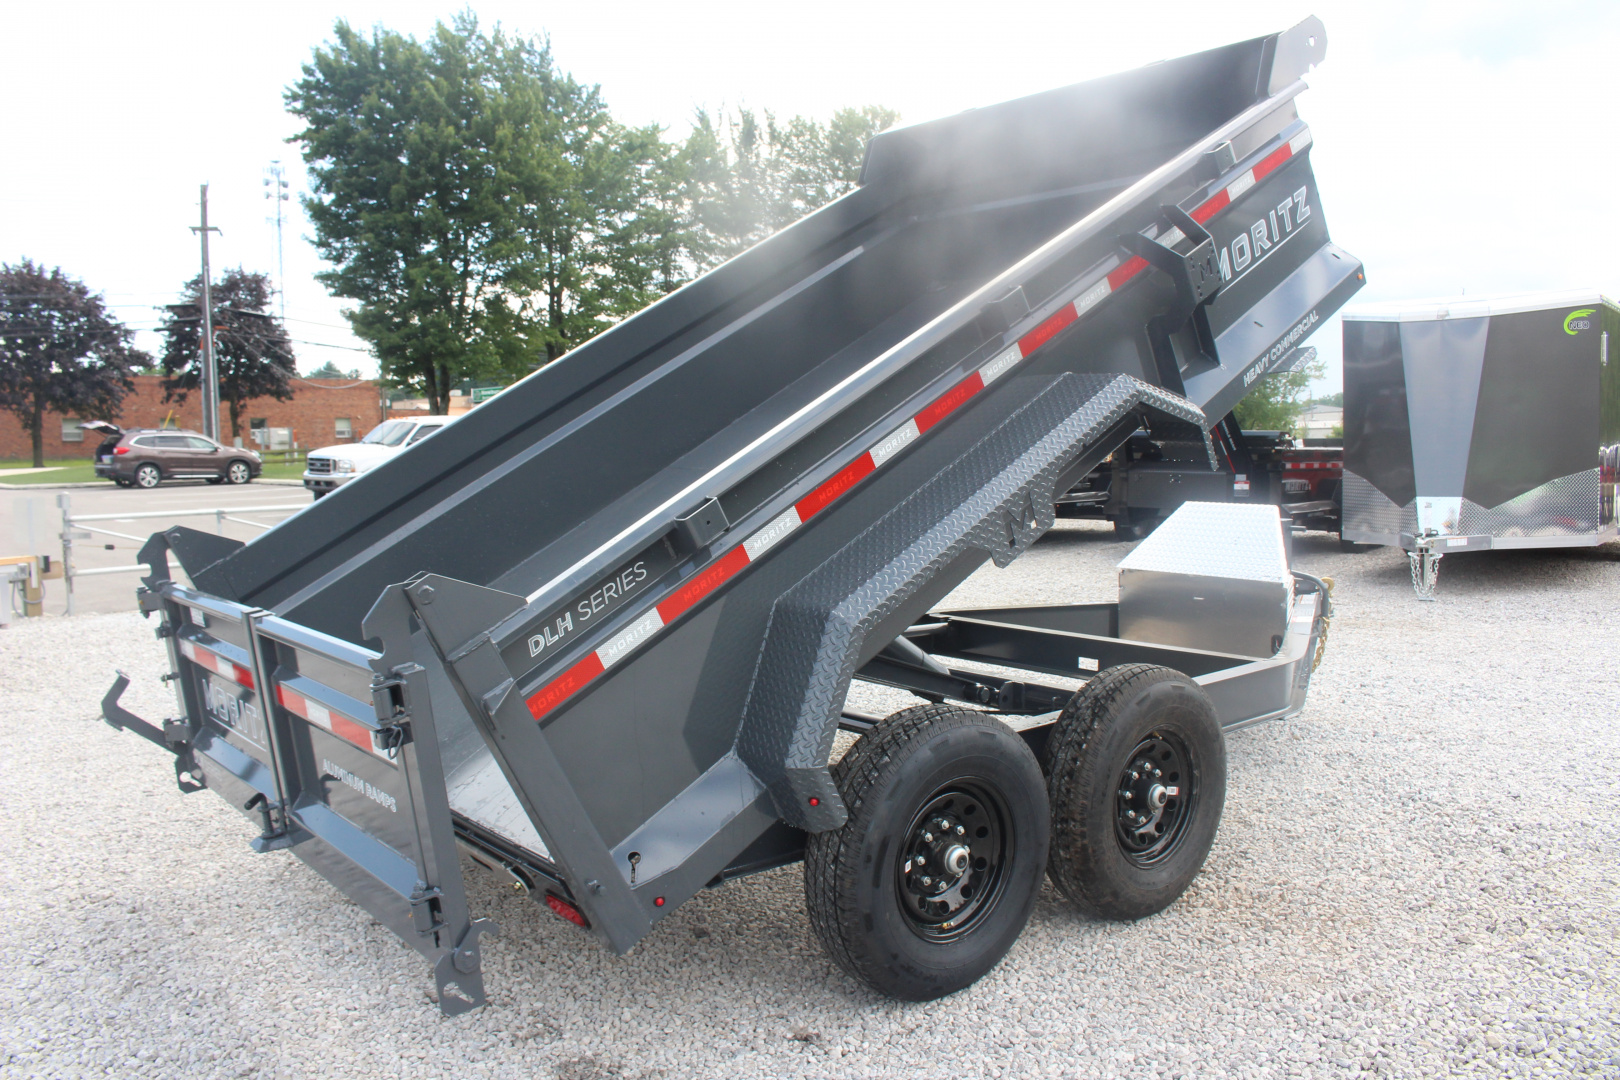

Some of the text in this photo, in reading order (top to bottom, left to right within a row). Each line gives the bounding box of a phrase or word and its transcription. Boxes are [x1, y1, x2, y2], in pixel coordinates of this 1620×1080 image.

[1161, 228, 1184, 246] MORIT
[1080, 285, 1106, 309] MORITZ
[1036, 317, 1063, 341] MORITZ
[985, 351, 1016, 377] MORITZ
[1243, 310, 1319, 387] HEAVY COMMERCIAL
[934, 388, 966, 416] MORITZ
[878, 429, 912, 457] MORITZ
[819, 471, 855, 503] MORITZ
[753, 517, 792, 550] MORITZ
[683, 566, 726, 601] MORITZ
[527, 561, 647, 658] DLH SERIES
[608, 620, 653, 657] MORITZ
[323, 758, 397, 813] ALUMINUM RAMPS
